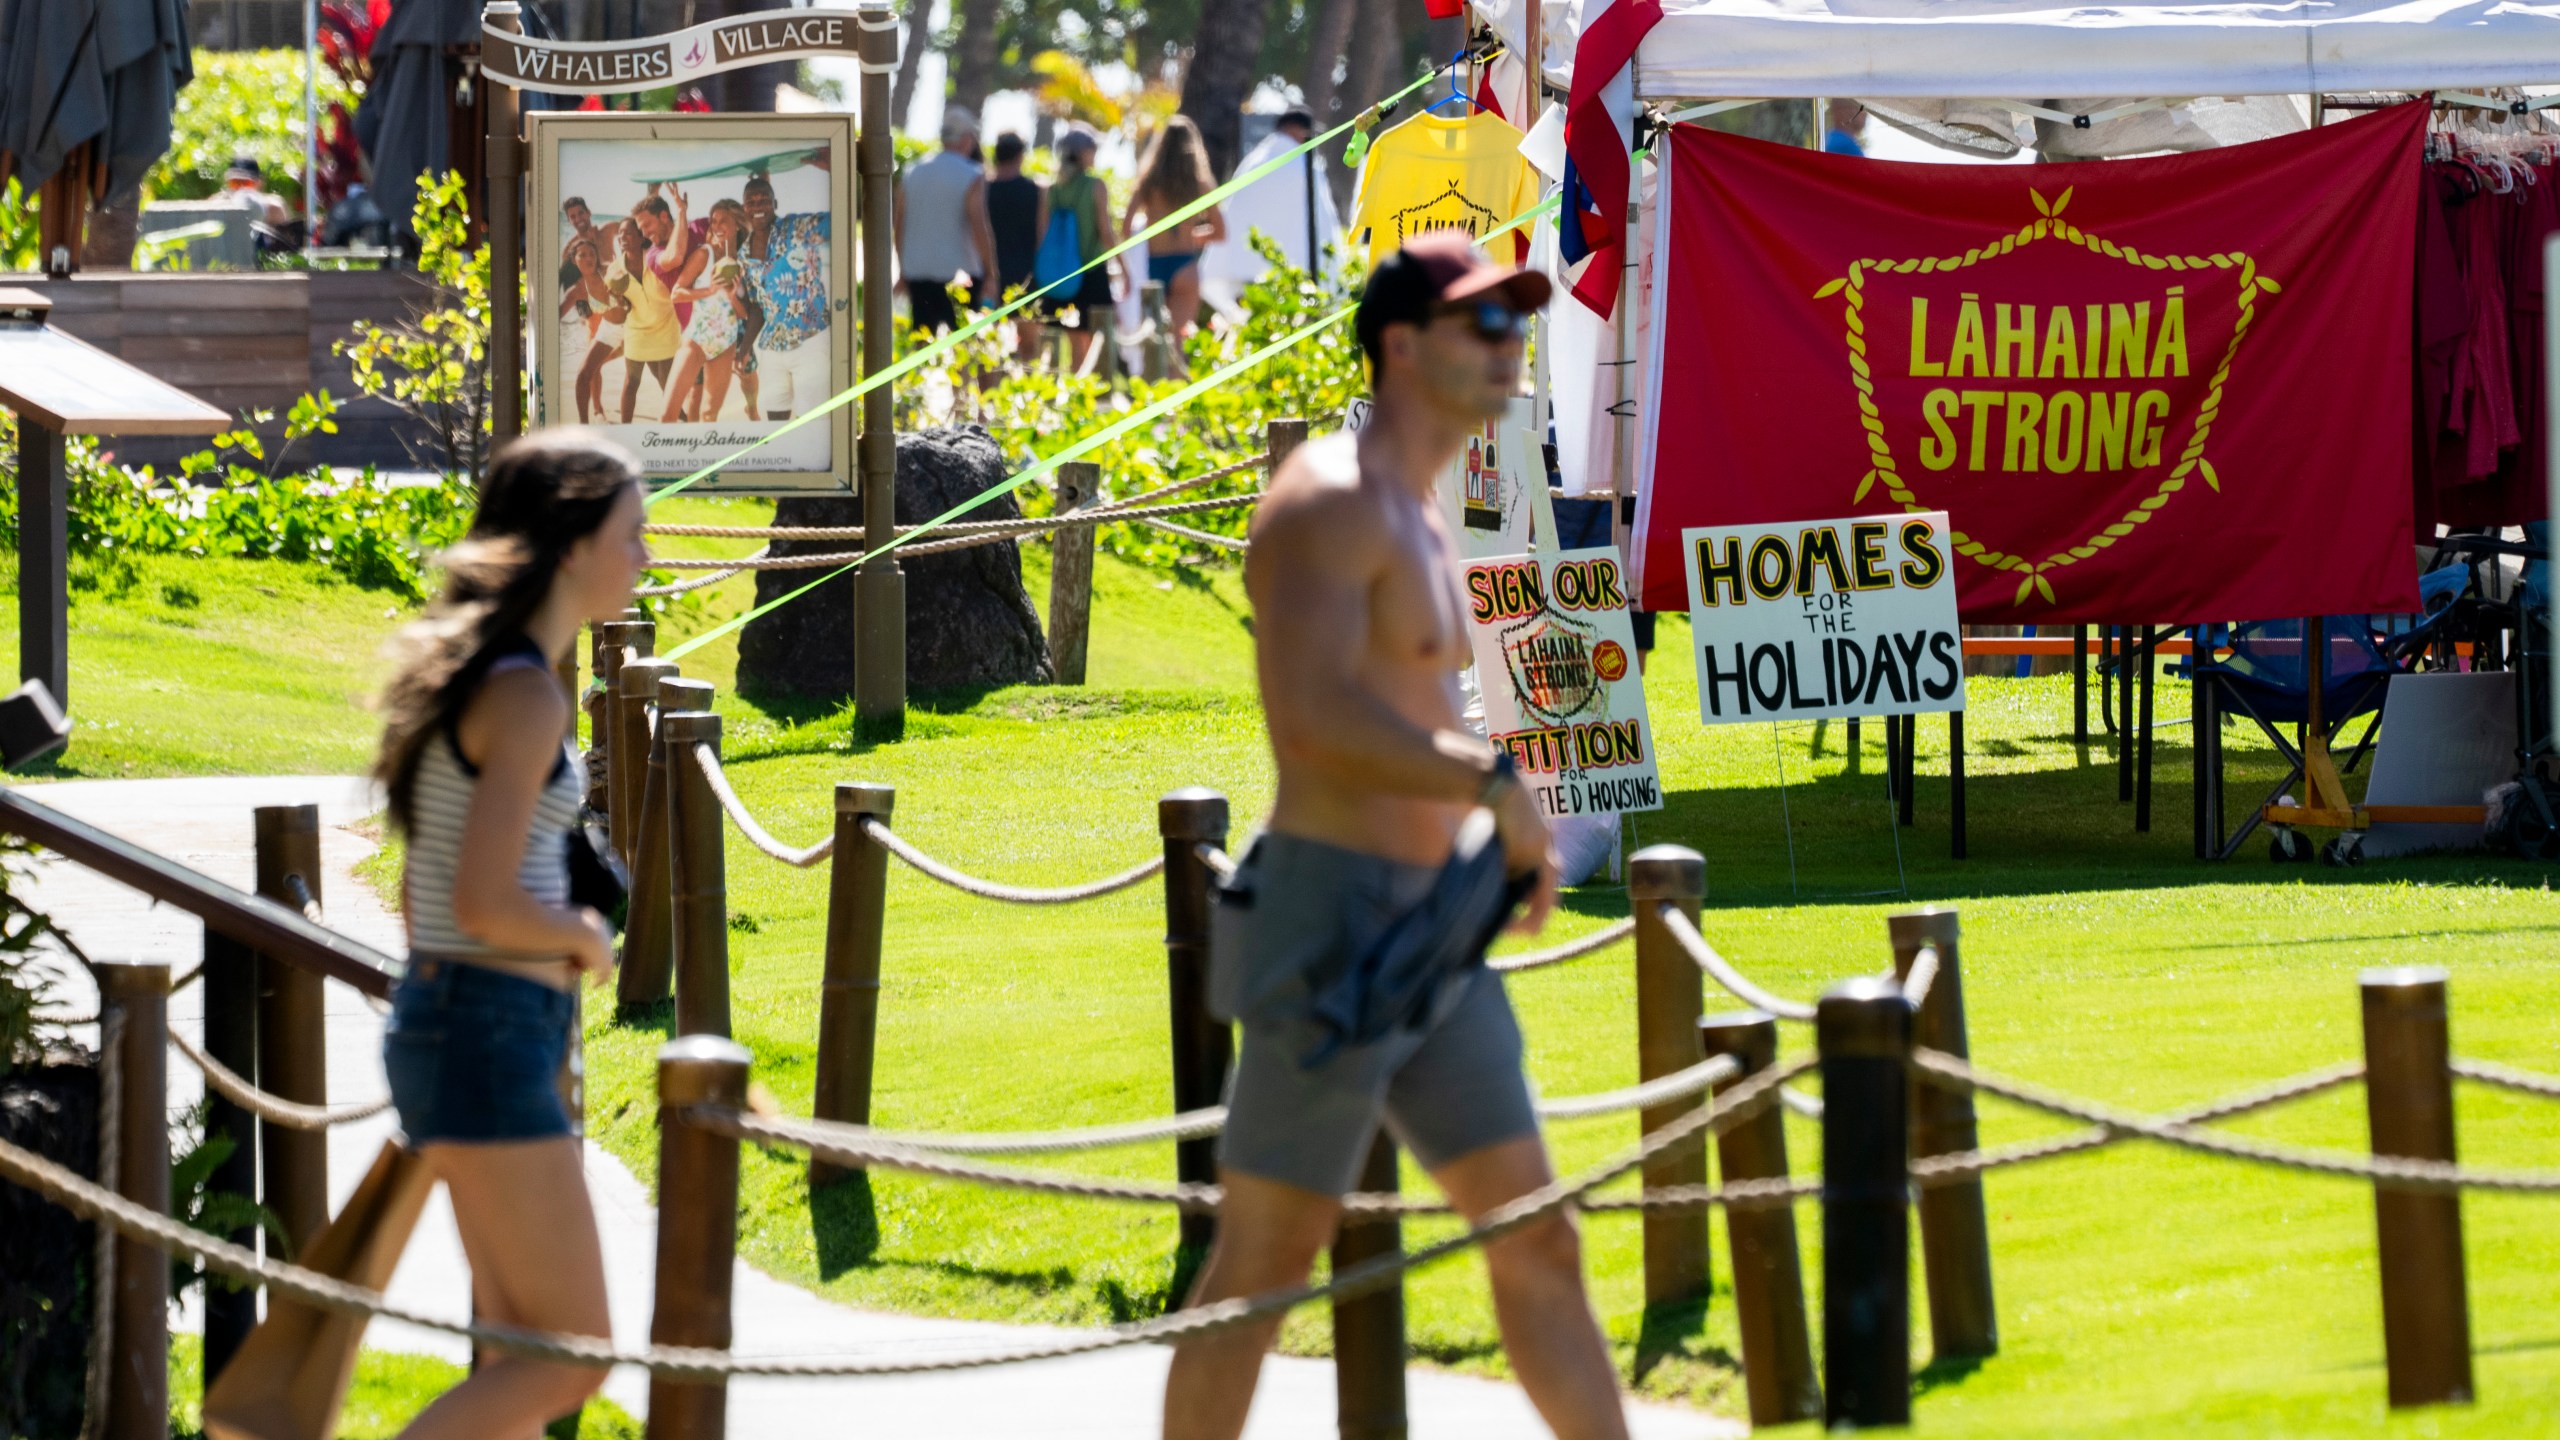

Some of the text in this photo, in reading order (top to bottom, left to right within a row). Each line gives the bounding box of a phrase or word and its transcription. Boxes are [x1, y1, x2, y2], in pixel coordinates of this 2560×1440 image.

[514, 19, 843, 80] WHALERS VILLAGE
[1909, 285, 2190, 379] LĀHAINĀ
[641, 431, 700, 453] Tommy
[1919, 387, 2170, 475] STRONG
[663, 459, 685, 468] NEXT
[687, 459, 699, 467] TO
[719, 457, 749, 467] HALE
[752, 456, 792, 466] PAVILION
[1696, 519, 1945, 608] HOMES
[1465, 558, 1628, 625] SIGN OUR
[1803, 592, 1853, 612] FOR
[1803, 612, 1856, 633] THE
[1524, 663, 1589, 691] STRONG
[1704, 630, 1959, 716] HOLIDAYS
[1489, 718, 1645, 775] PETITION
[1559, 768, 1588, 782] FOR
[1588, 776, 1657, 814] HOUSING
